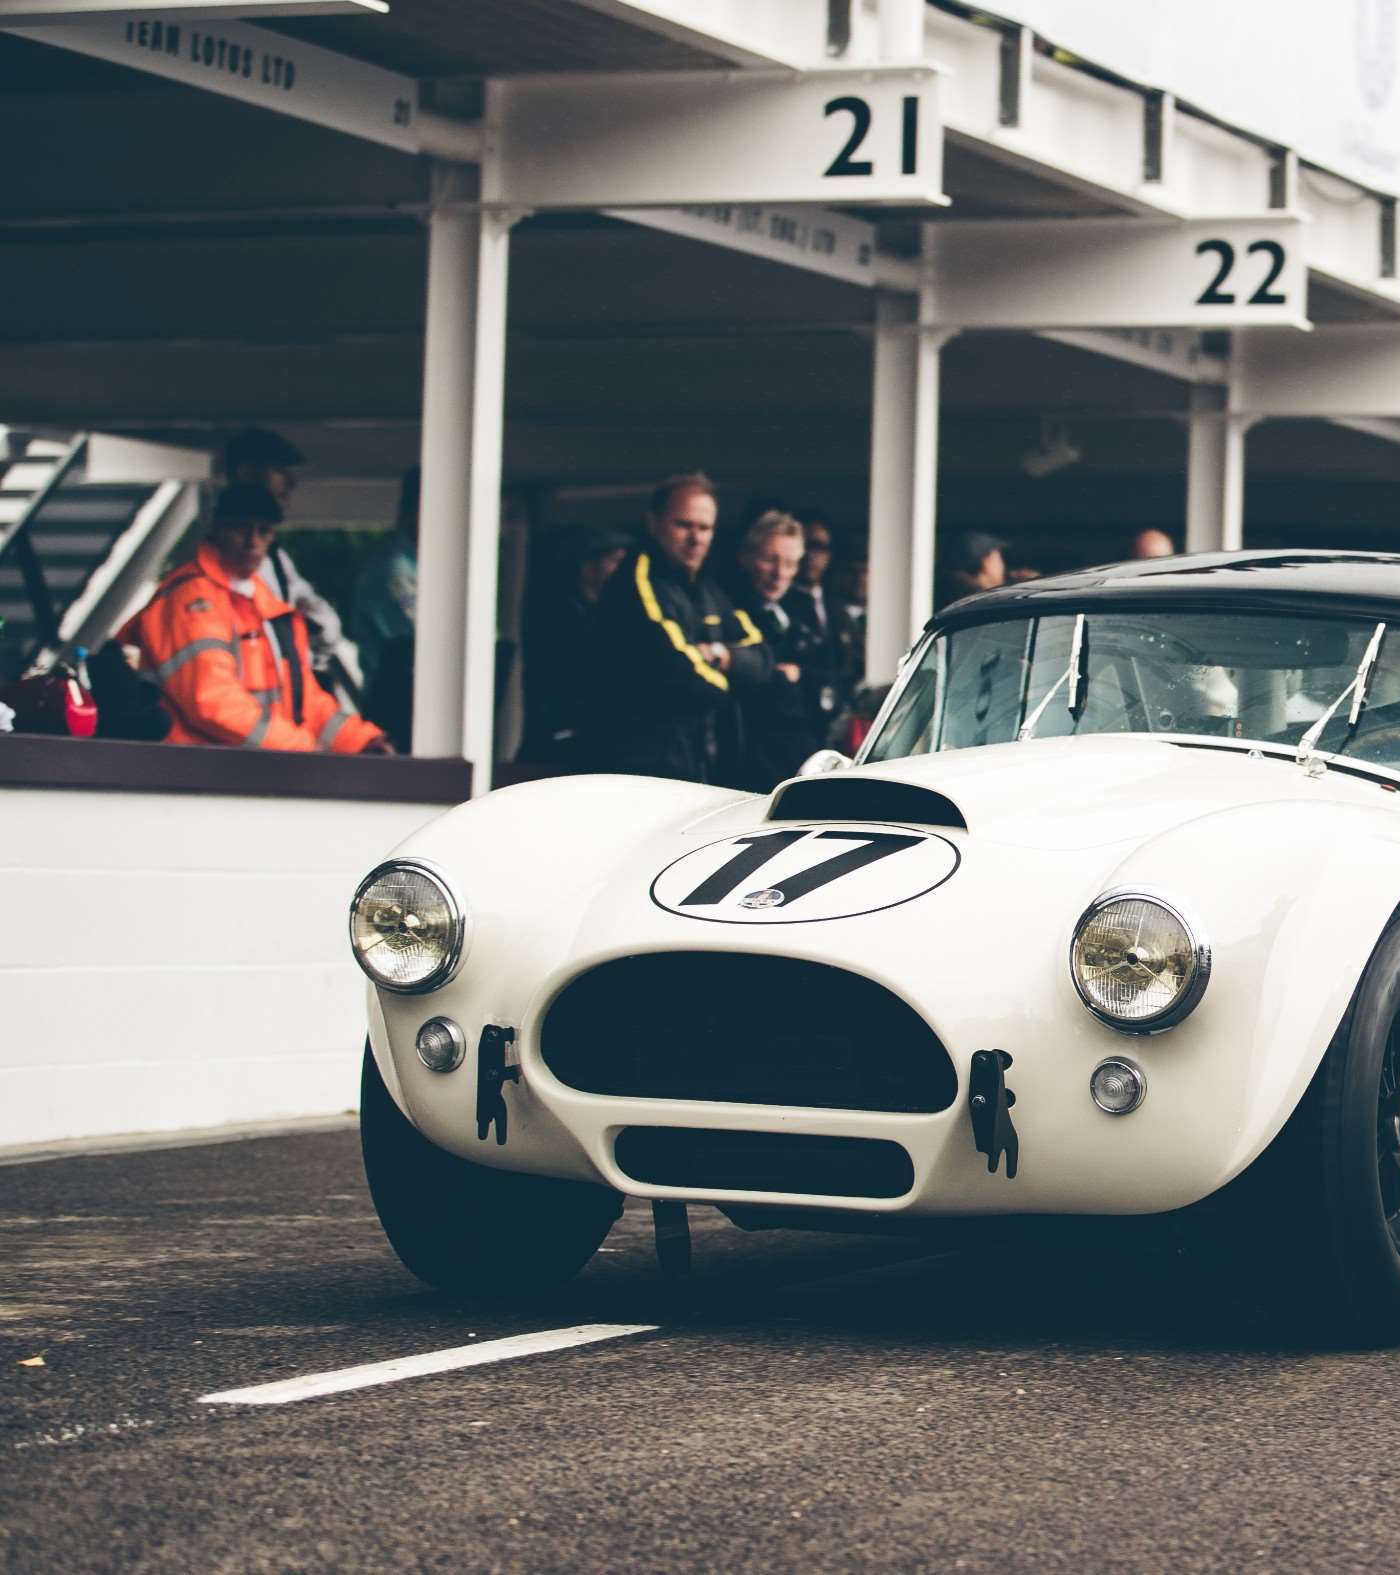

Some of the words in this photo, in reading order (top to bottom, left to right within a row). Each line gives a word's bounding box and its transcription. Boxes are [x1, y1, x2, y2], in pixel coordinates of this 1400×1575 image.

[126, 20, 180, 56] TEAM
[191, 31, 253, 79] LOTUS
[262, 53, 297, 91] LTD
[823, 95, 919, 178] 21
[1195, 238, 1287, 305] 22
[678, 830, 929, 908] 17
